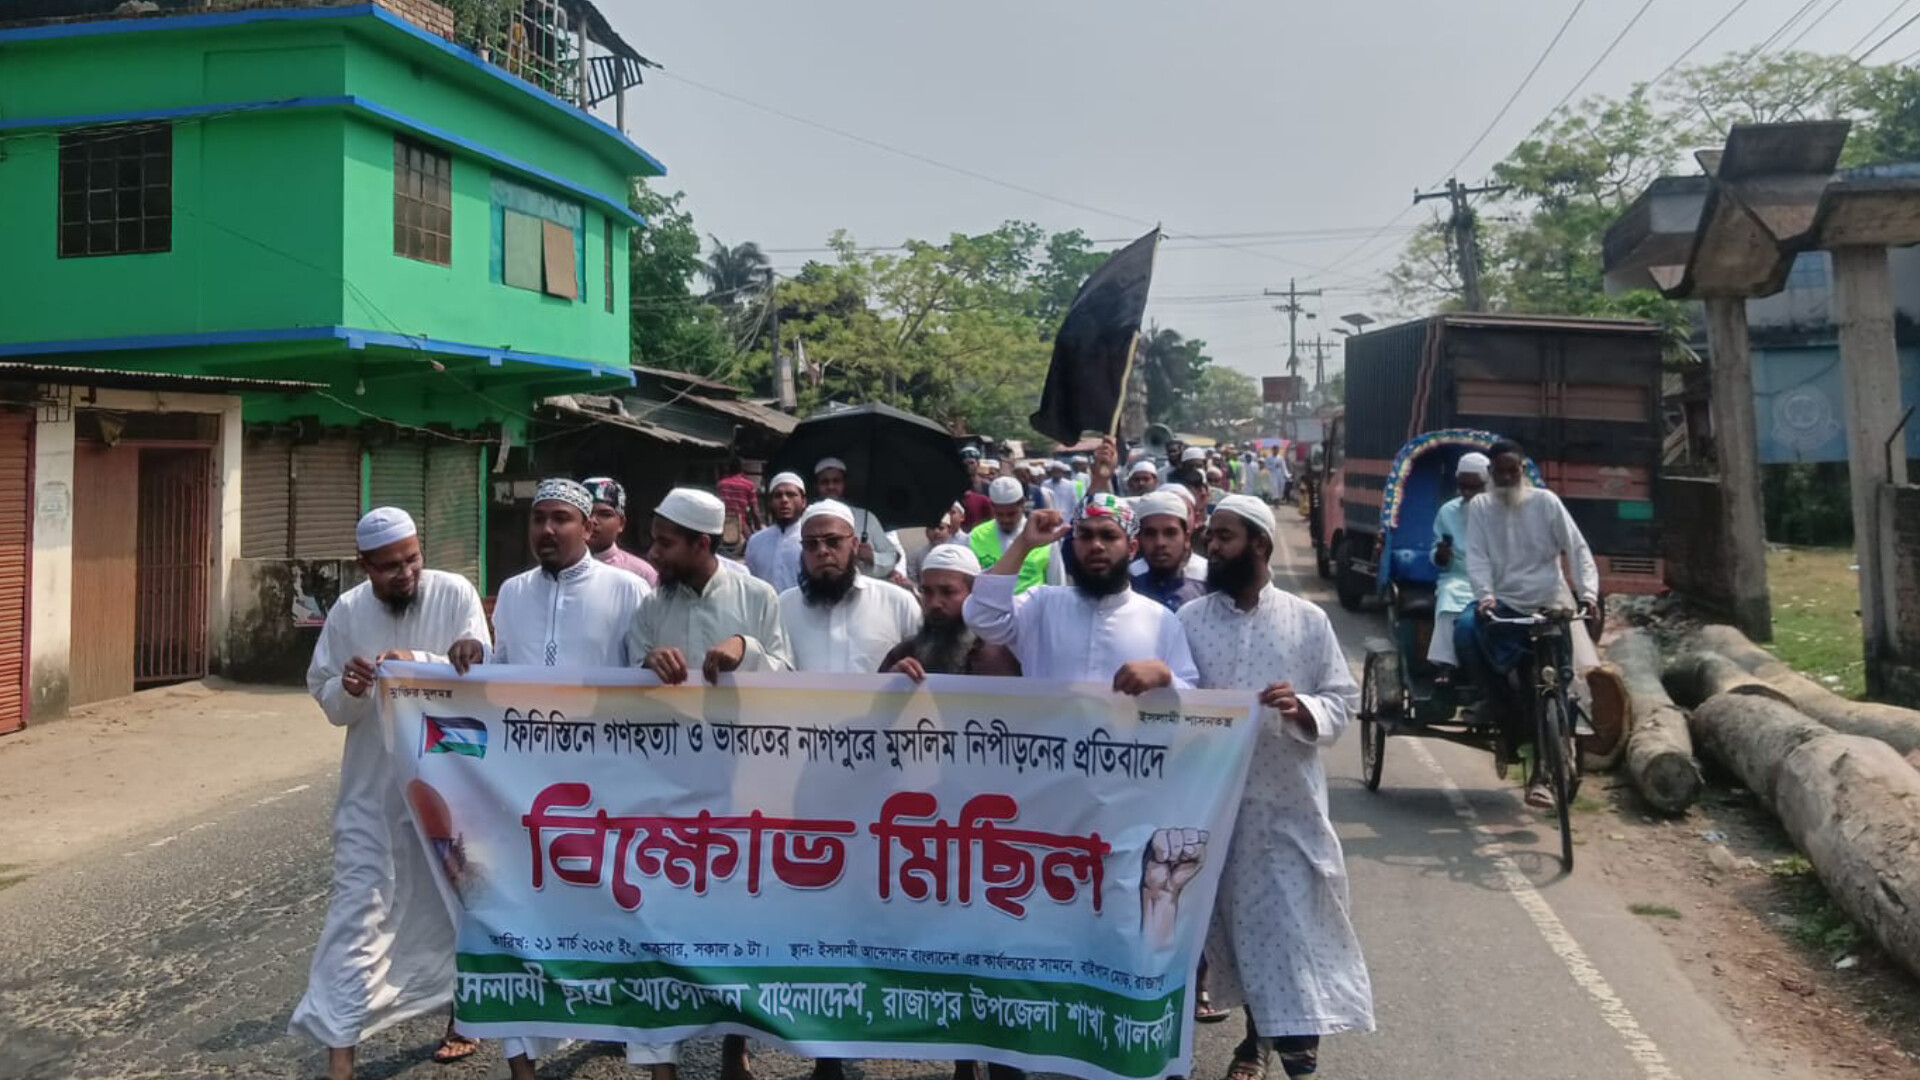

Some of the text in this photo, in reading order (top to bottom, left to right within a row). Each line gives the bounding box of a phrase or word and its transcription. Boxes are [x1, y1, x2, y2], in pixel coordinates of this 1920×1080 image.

[502, 708, 1169, 780] ফিলিস্তিনে গণহত্যা ও ভারতের নাগপুরে মুসলিম নিপীড়নের প্রতিবাদে
[521, 782, 1112, 918] বিক্ষোভ মিছিল
[535, 937, 552, 951] ২১
[557, 932, 579, 950] মার্চ
[582, 938, 614, 954] ২০২৫
[693, 942, 729, 957] সকাল
[734, 943, 743, 957] ৯
[818, 939, 857, 959] ইসলামী
[860, 945, 908, 963] আন্দোলন
[911, 948, 960, 966] বাংলাদেশ
[962, 954, 980, 967] এর
[457, 962, 549, 1007] সলামী
[620, 976, 751, 1013] আন্দোলন
[758, 981, 873, 1025] বাংলাদেশ,
[881, 986, 963, 1029] রাজাপুর
[969, 982, 1060, 1033] উপজেলা
[1065, 1001, 1108, 1051] শাখা,
